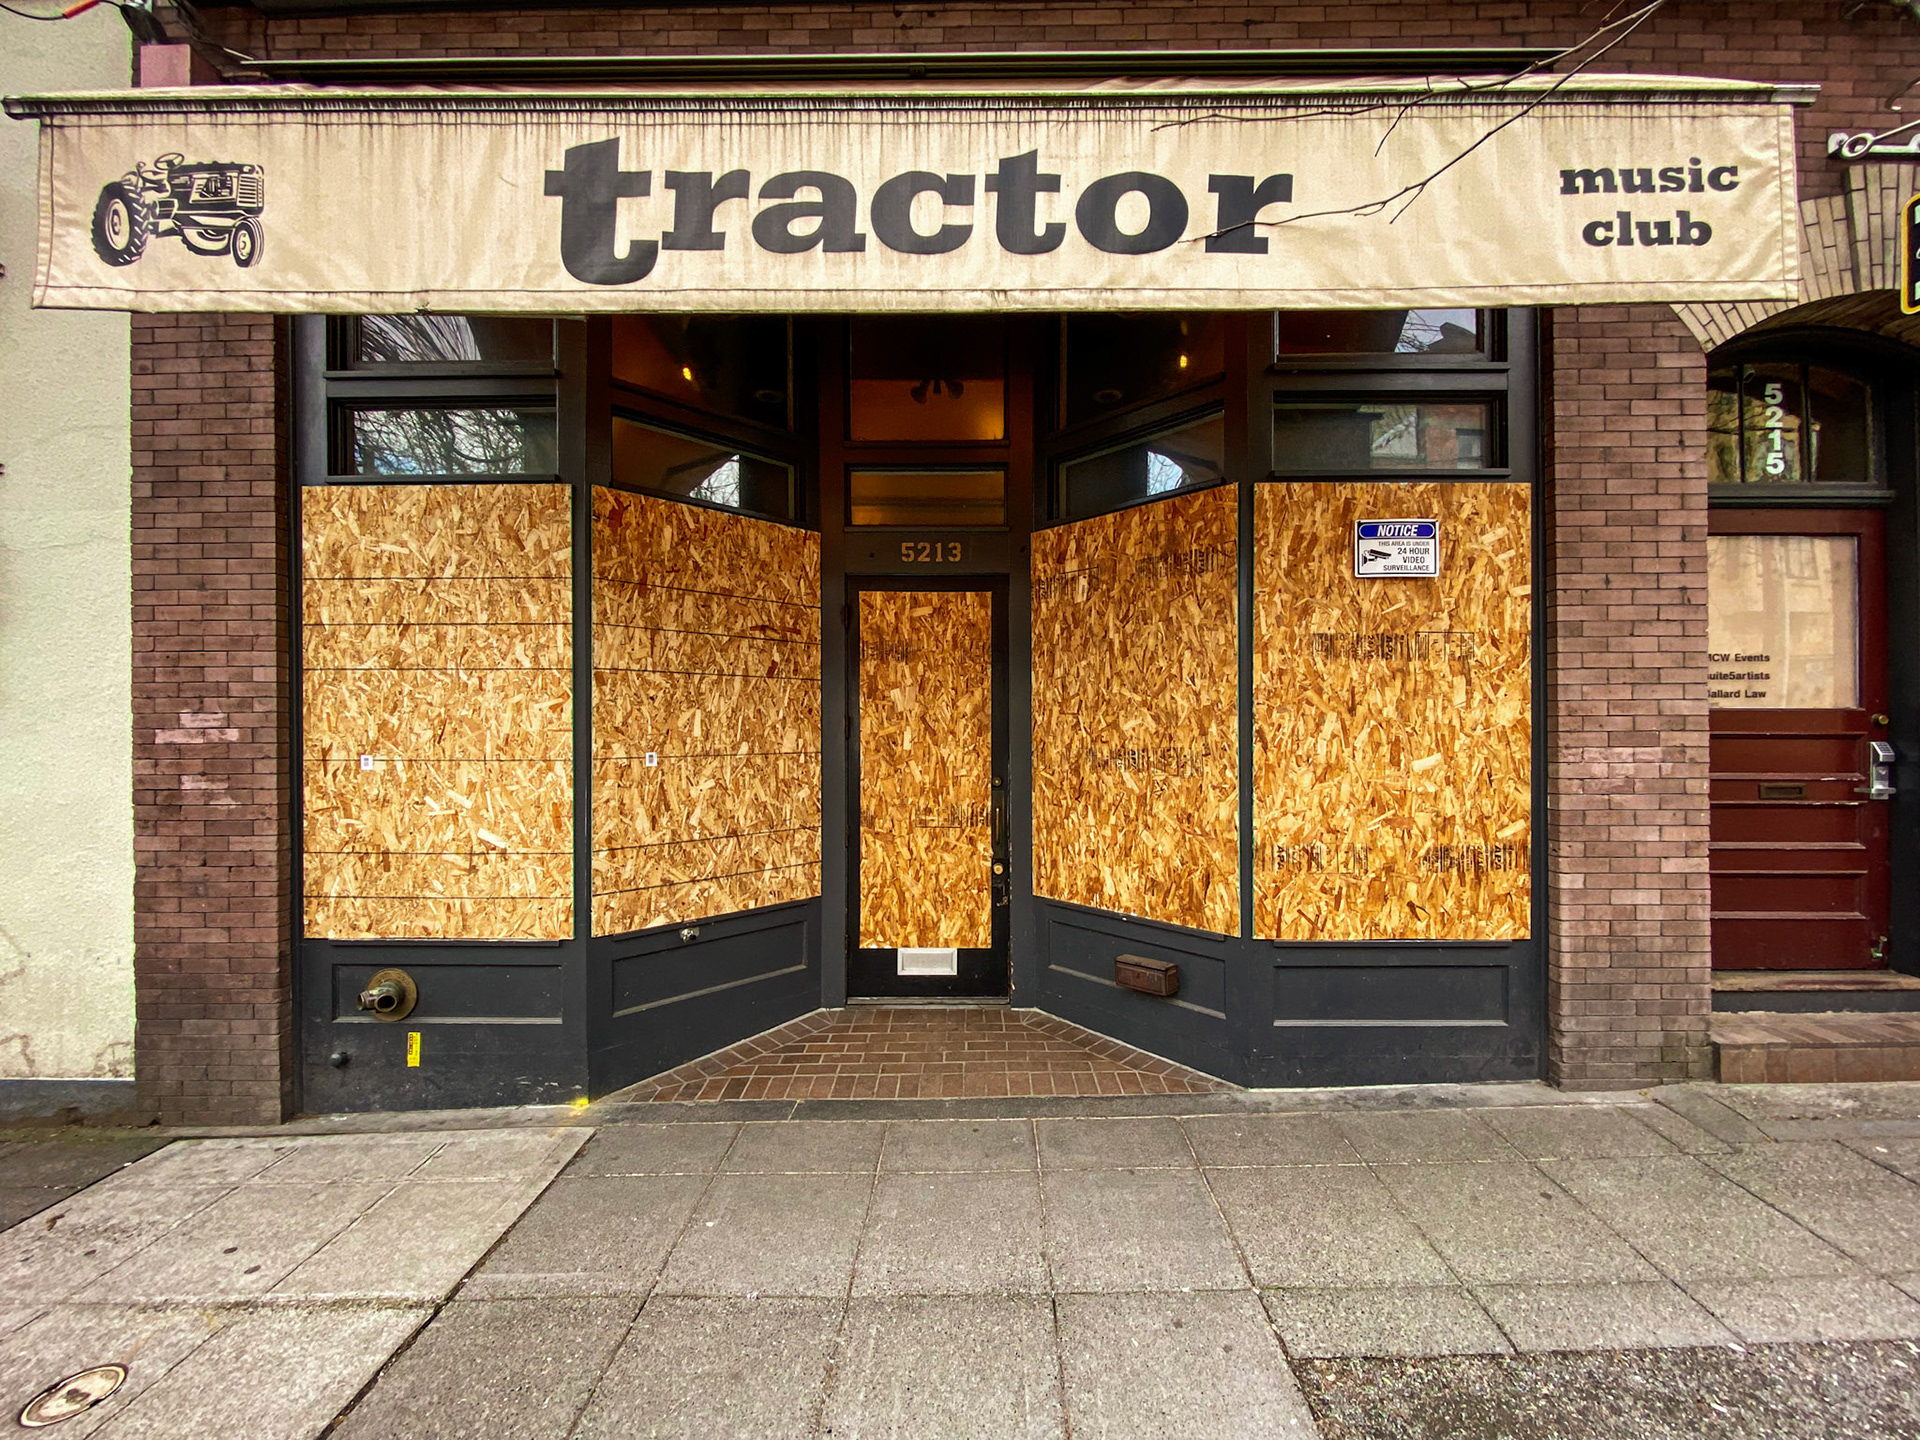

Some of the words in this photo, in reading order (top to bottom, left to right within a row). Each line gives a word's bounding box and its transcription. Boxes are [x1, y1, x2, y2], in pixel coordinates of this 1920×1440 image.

[1559, 156, 1740, 195] music
[543, 135, 1294, 286] tractor
[1581, 210, 1713, 247] club
[1764, 383, 1786, 475] 5215
[1377, 525, 1418, 536] NOTICE
[900, 541, 963, 563] 5213
[1397, 547, 1407, 555] 24
[1409, 547, 1430, 555] HOUR
[1402, 556, 1426, 564] VIDEO
[1734, 653, 1771, 662] Events
[1744, 689, 1767, 698] Law
